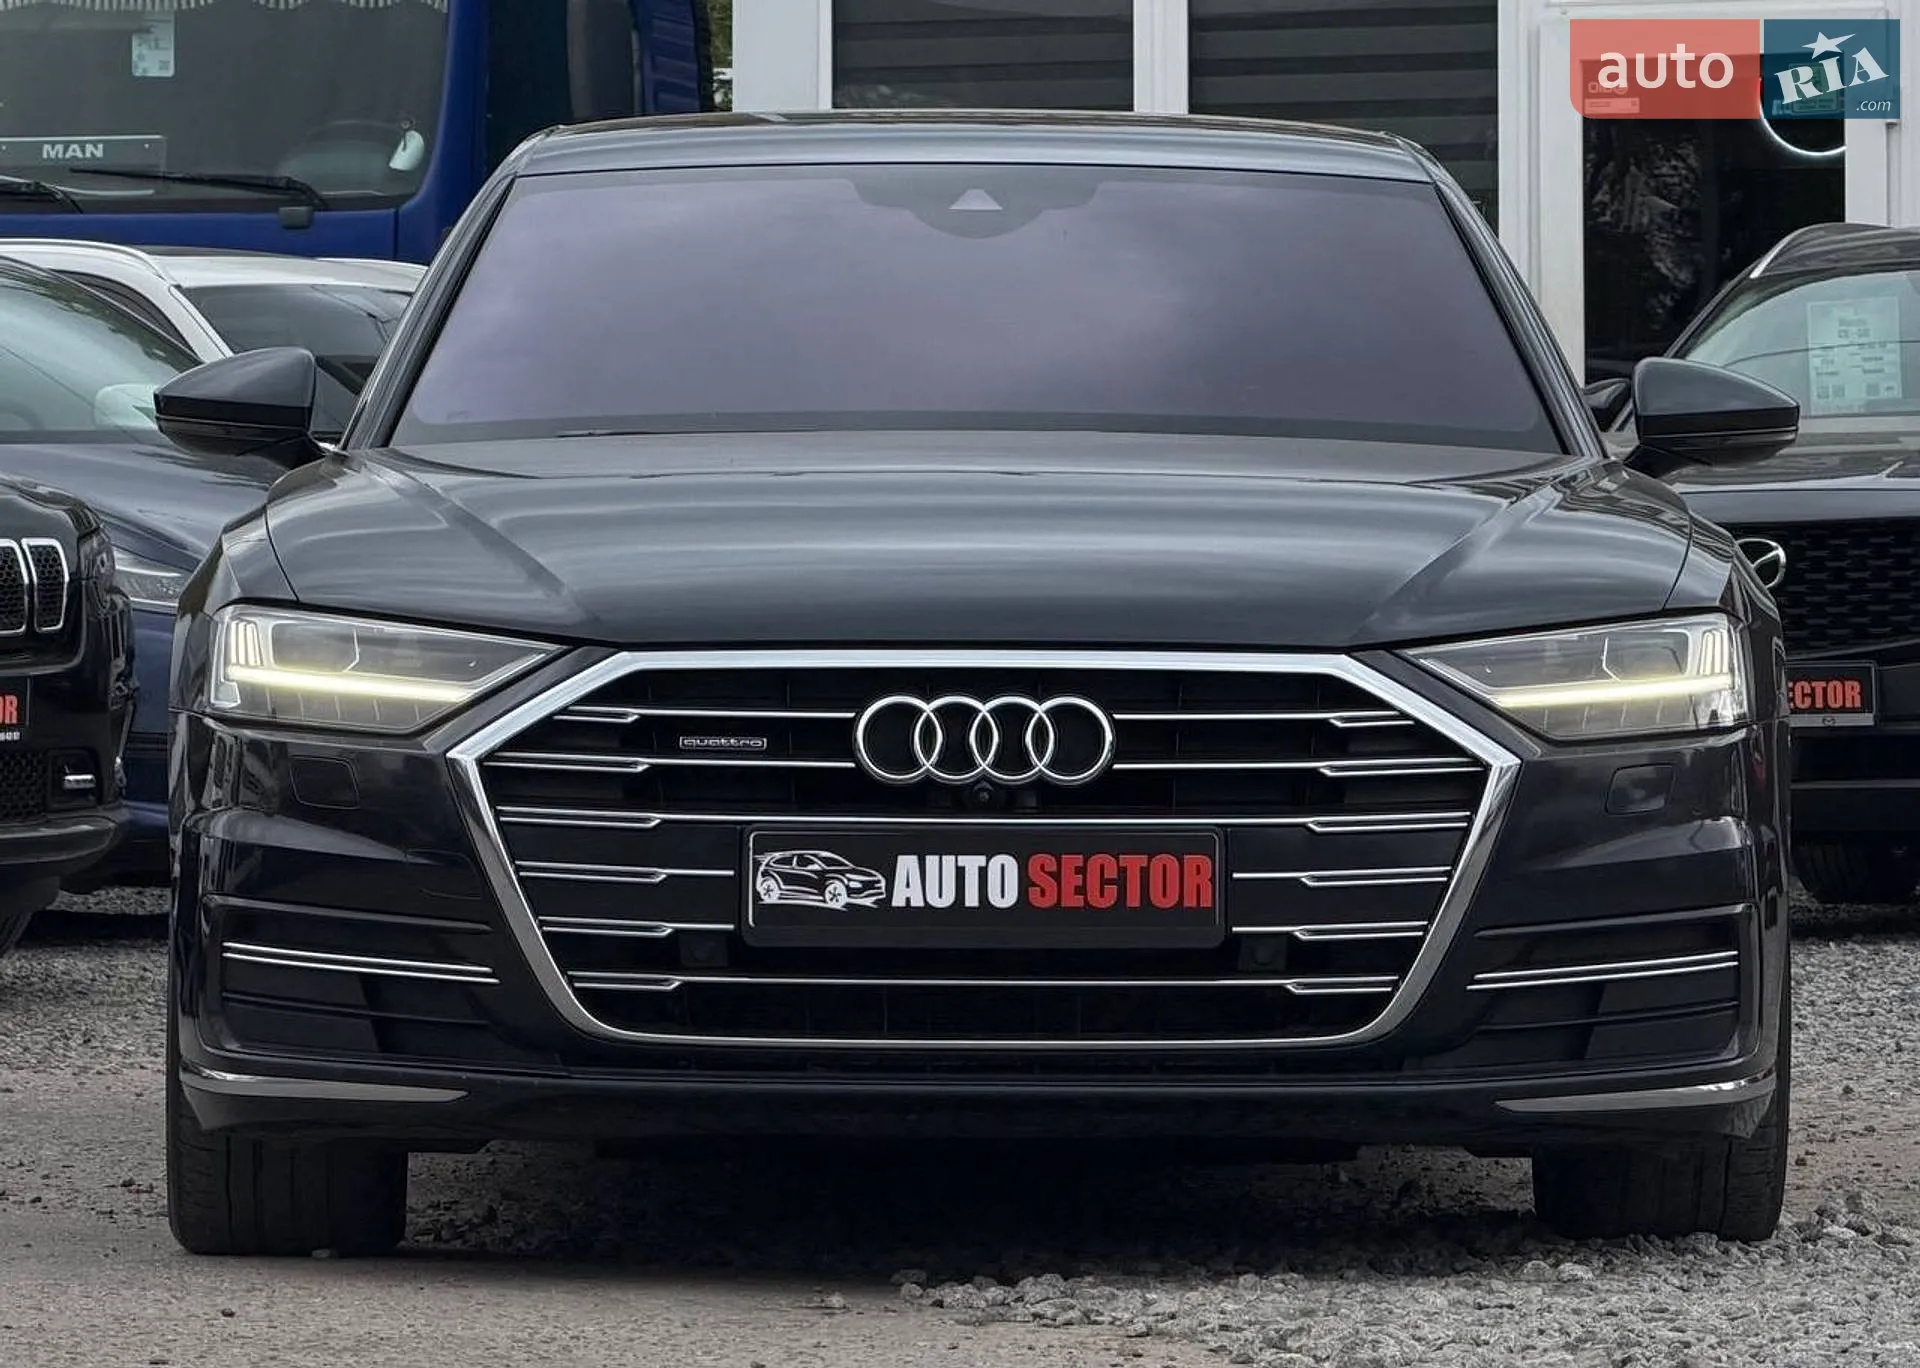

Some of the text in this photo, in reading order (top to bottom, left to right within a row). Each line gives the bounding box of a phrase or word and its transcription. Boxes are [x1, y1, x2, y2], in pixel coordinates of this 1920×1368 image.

[42, 143, 104, 159] MAN
[683, 738, 763, 750] quattro
[891, 854, 1212, 908] AUTO SECTOR
